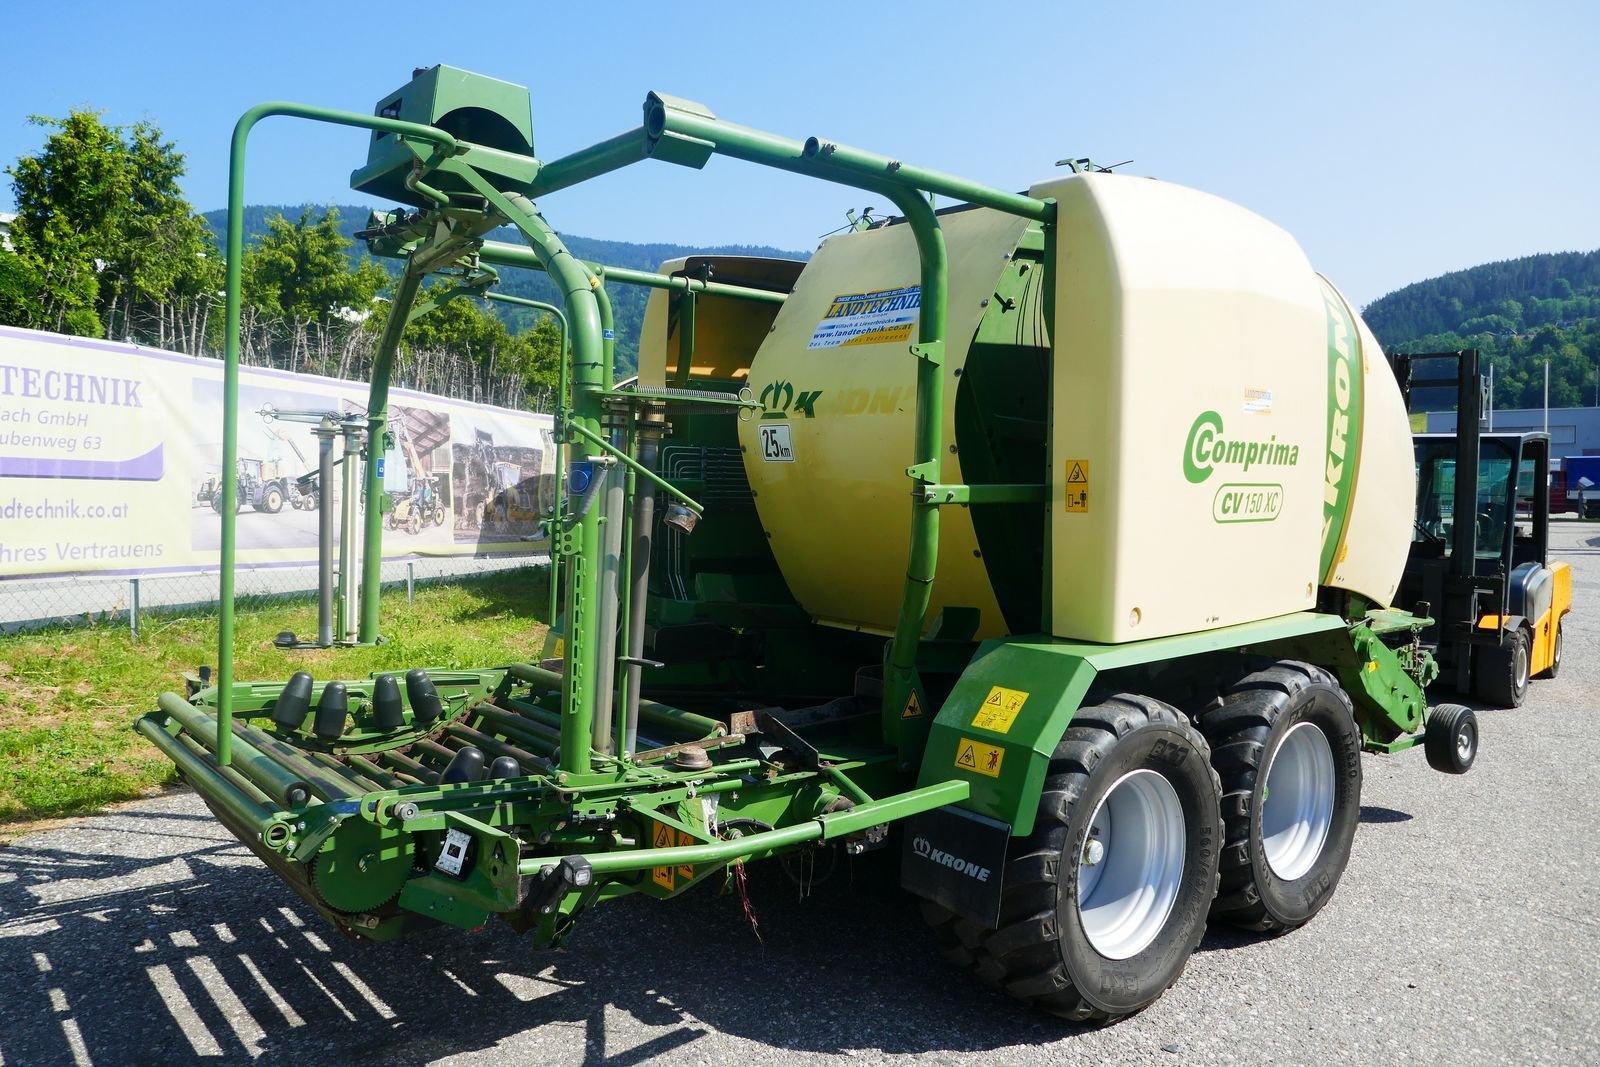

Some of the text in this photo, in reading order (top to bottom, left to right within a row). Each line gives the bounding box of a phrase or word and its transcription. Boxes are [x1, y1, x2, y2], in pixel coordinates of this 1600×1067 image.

[813, 322, 913, 340] www.landtechnik.co.at
[0, 365, 143, 408] TECHNIK
[37, 409, 89, 427] GmbH
[83, 435, 102, 450] 63
[1221, 491, 1279, 514] CV 150 XC
[55, 541, 163, 561] Vertrauens
[1150, 738, 1189, 766] BKT
[930, 848, 992, 882] KRONE
